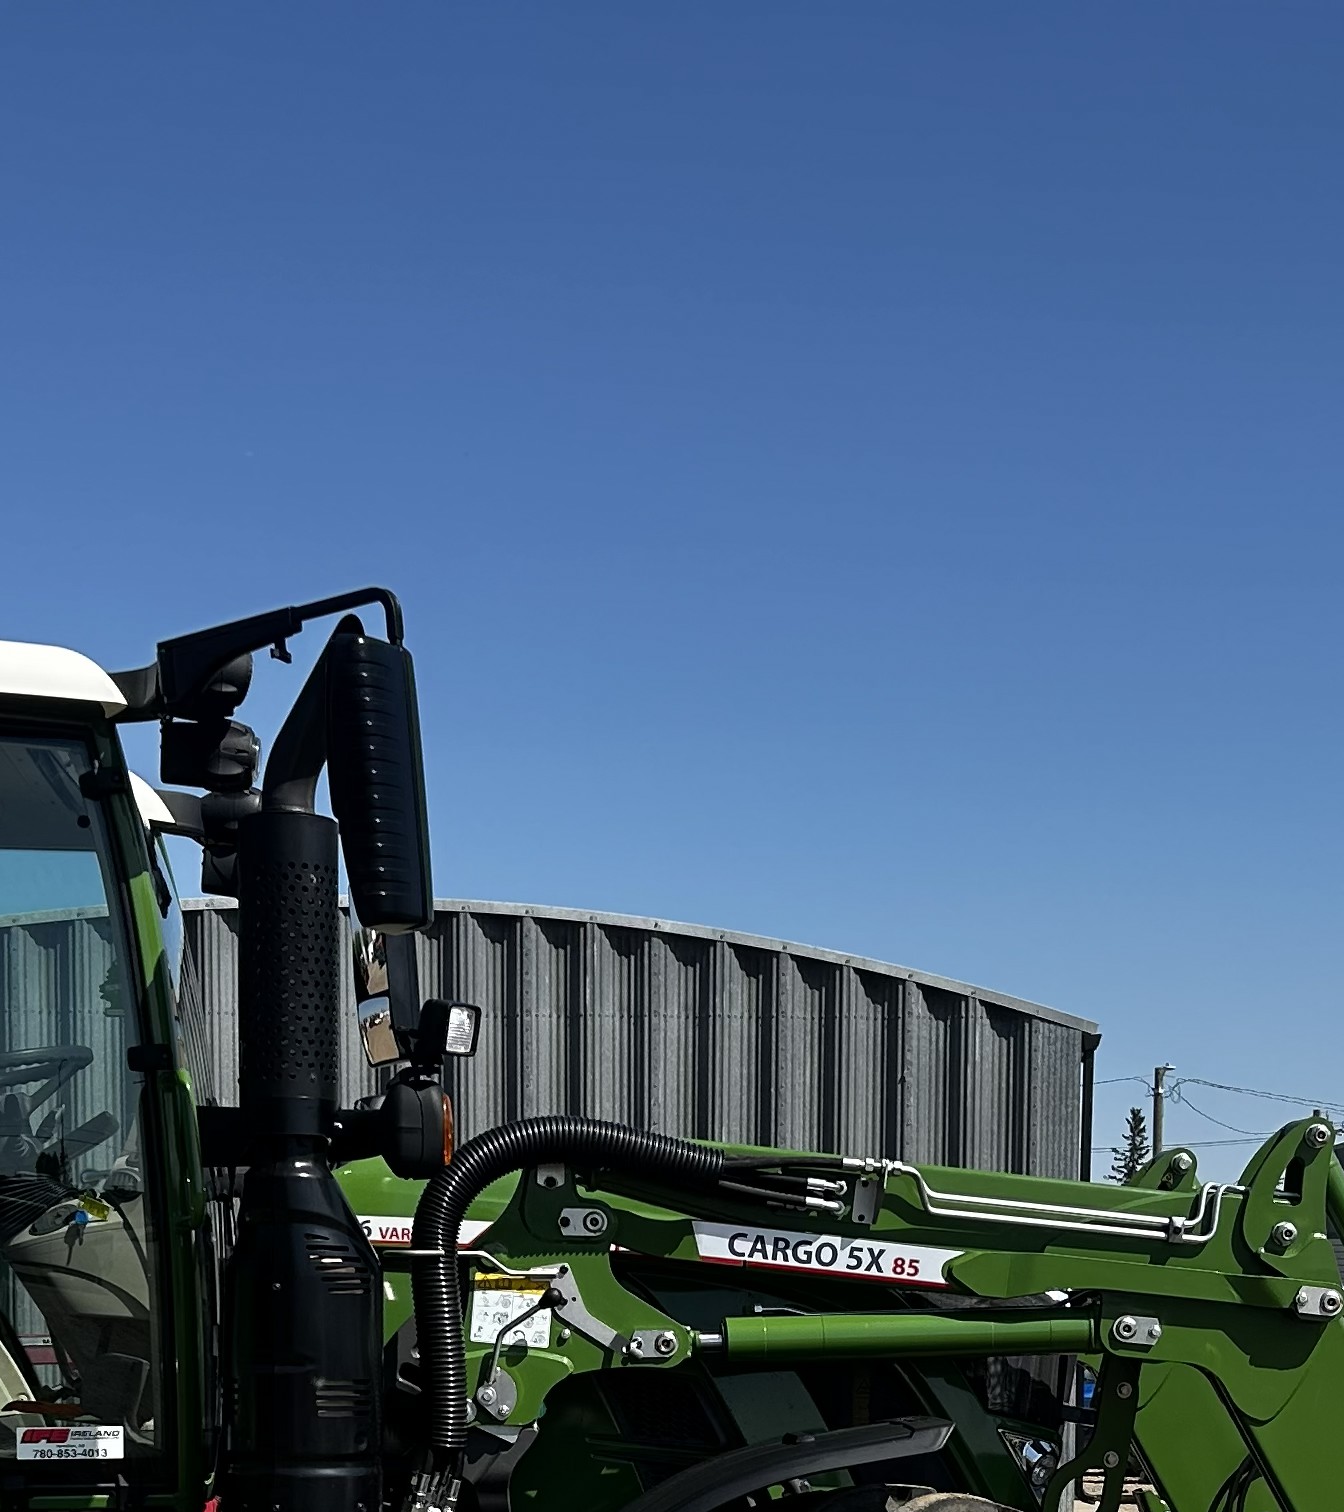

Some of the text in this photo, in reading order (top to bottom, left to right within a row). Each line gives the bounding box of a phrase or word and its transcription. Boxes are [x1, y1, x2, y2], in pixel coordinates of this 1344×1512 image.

[728, 1232, 920, 1277] CARGO 5X 85
[32, 1448, 108, 1459] 780-853-4013
